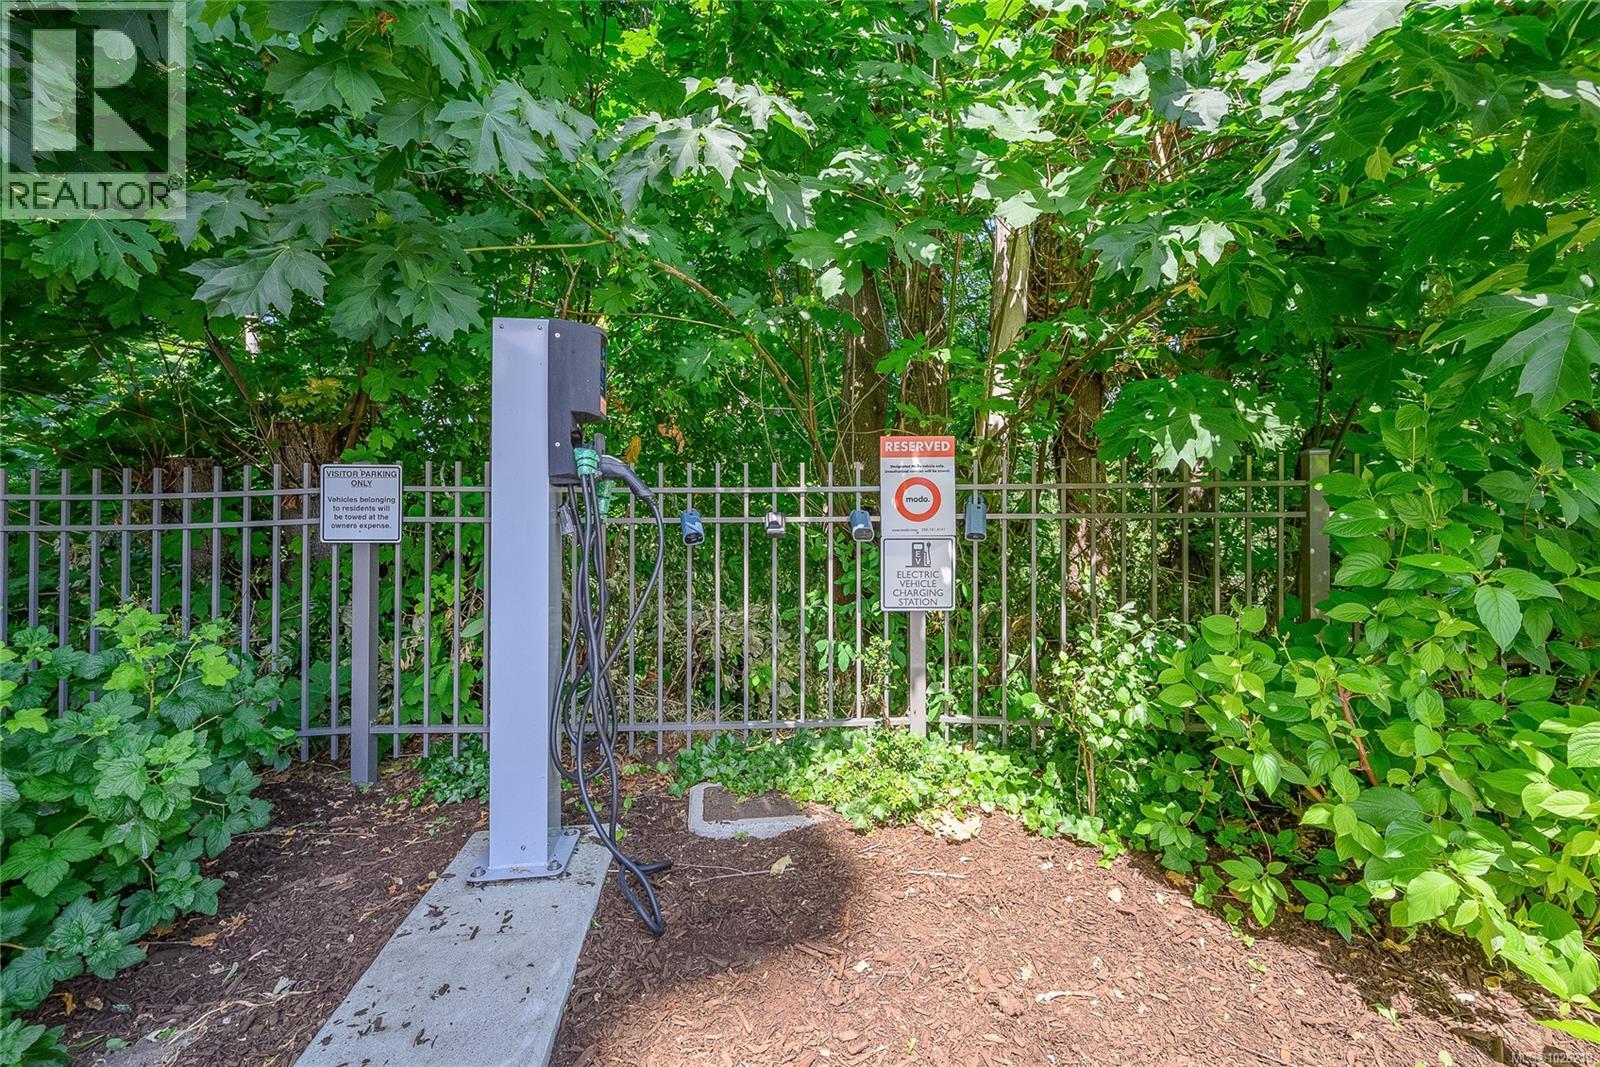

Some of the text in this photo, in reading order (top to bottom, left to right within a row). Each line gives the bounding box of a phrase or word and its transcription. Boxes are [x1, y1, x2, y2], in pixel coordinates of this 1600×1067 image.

[885, 441, 950, 452] RESERVED
[326, 470, 397, 478] VISITOR PARKING
[360, 496, 396, 504] belonging
[896, 571, 940, 579] ELECTRIC
[899, 580, 937, 588] VEHICLE
[892, 589, 944, 597] CHARGING
[898, 598, 938, 606] STATION
